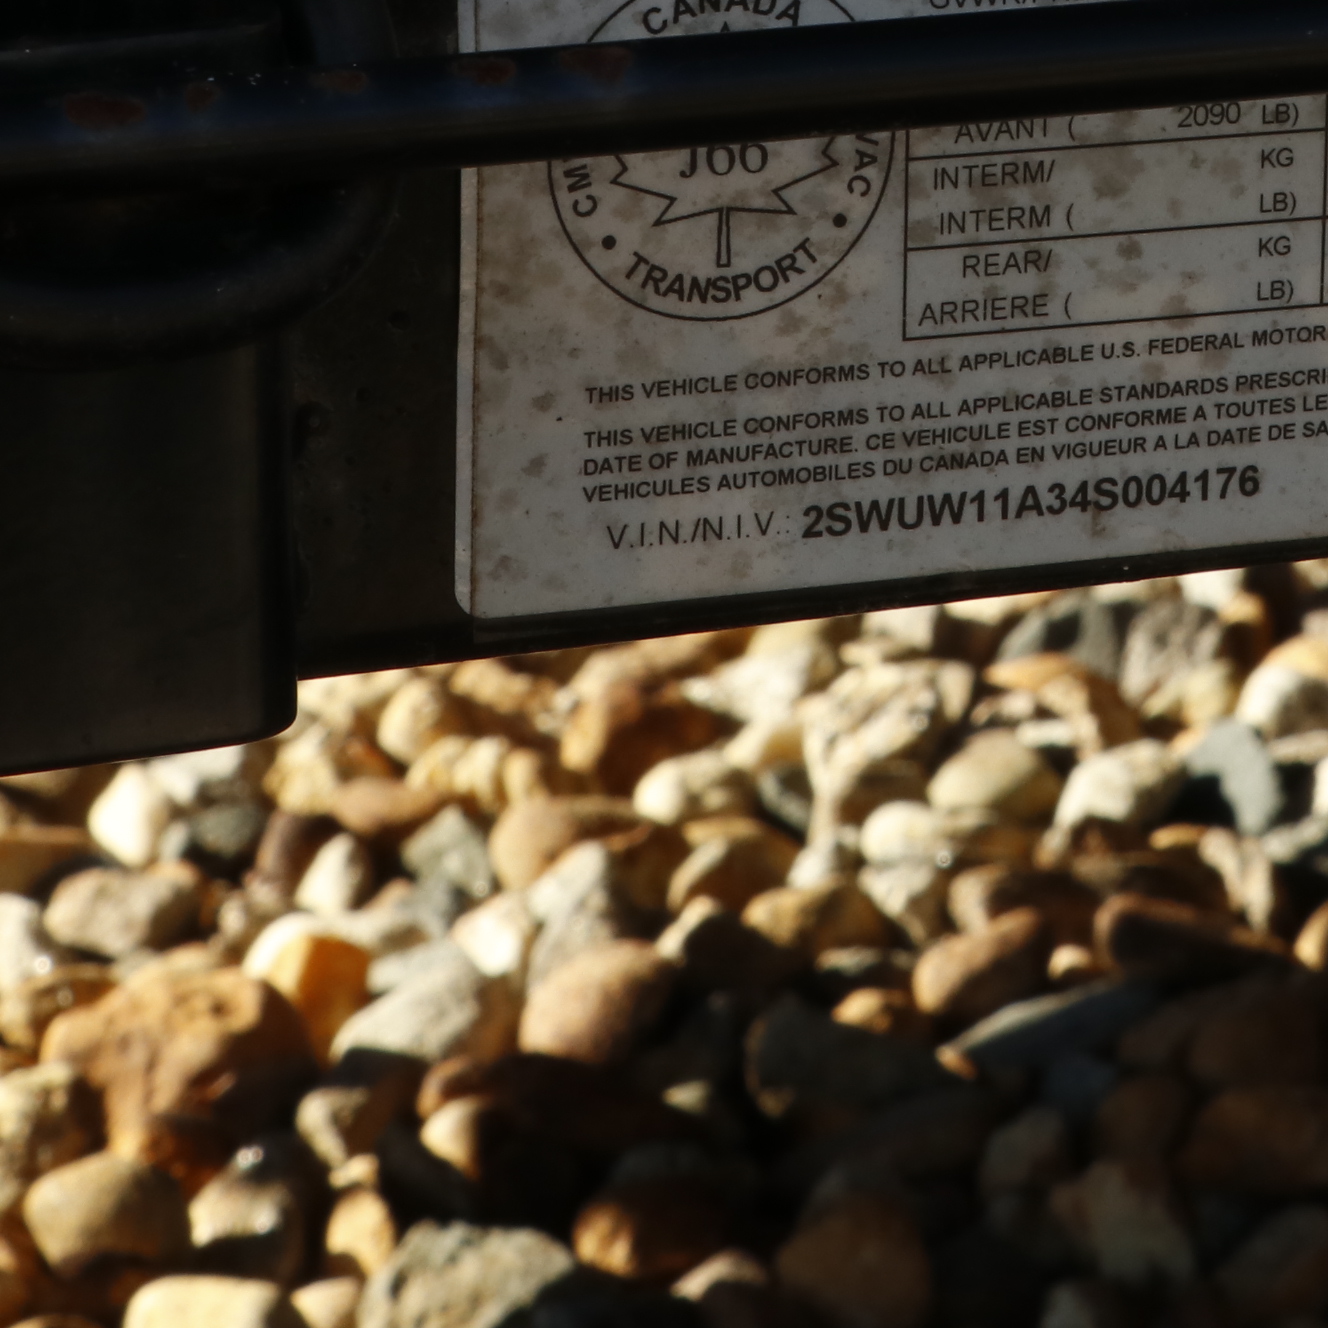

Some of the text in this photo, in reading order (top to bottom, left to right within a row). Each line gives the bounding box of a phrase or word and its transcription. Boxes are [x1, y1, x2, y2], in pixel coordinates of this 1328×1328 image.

[1177, 105, 1241, 128] 2090
[933, 159, 1056, 191] INTERM/
[1260, 147, 1294, 169] KG
[940, 204, 1051, 235] INTERM
[1258, 235, 1291, 258] KG
[624, 237, 818, 304] TRANSPORT
[962, 249, 1053, 279] REAR/
[918, 293, 1049, 327] ARRIERE
[584, 384, 635, 404] THIS
[641, 374, 738, 399] VEHICLE
[744, 363, 870, 390] CONFORMS
[877, 360, 906, 379] TO
[912, 356, 952, 376] ALL
[958, 344, 1094, 372] APPLICABLE
[1101, 341, 1142, 360] U.S.
[1148, 332, 1245, 356] FEDERAL
[1251, 325, 1326, 347] MOTOR
[583, 428, 634, 449] THIS
[640, 419, 737, 444] VEHICLE
[743, 407, 869, 435] CONFORMS
[875, 404, 905, 423] TO
[911, 401, 951, 421] ALL
[957, 388, 1093, 416] APPLICABLE
[1099, 376, 1229, 404] STANDARDS
[583, 454, 642, 476] DATE
[648, 451, 678, 470] OF
[686, 436, 859, 468] MANUFACTURE.
[865, 432, 896, 451] CE
[902, 422, 1011, 447] VEHICULE
[1017, 418, 1059, 438] EST
[1065, 406, 1187, 433] CONFORME
[1193, 404, 1207, 422] A
[1213, 397, 1296, 419] TOUTES
[582, 476, 711, 503] VEHICULES
[717, 461, 876, 492] AUTOMOBILES
[883, 457, 913, 476] DU
[919, 449, 1009, 473] CANADA
[1016, 445, 1045, 464] EN
[1051, 436, 1147, 461] VIGUEUR
[1153, 435, 1168, 452] A
[1174, 432, 1200, 450] LA
[1207, 426, 1262, 447] DATE
[1268, 422, 1296, 441] DE
[801, 464, 1260, 539] 2SWUW11A34S004176
